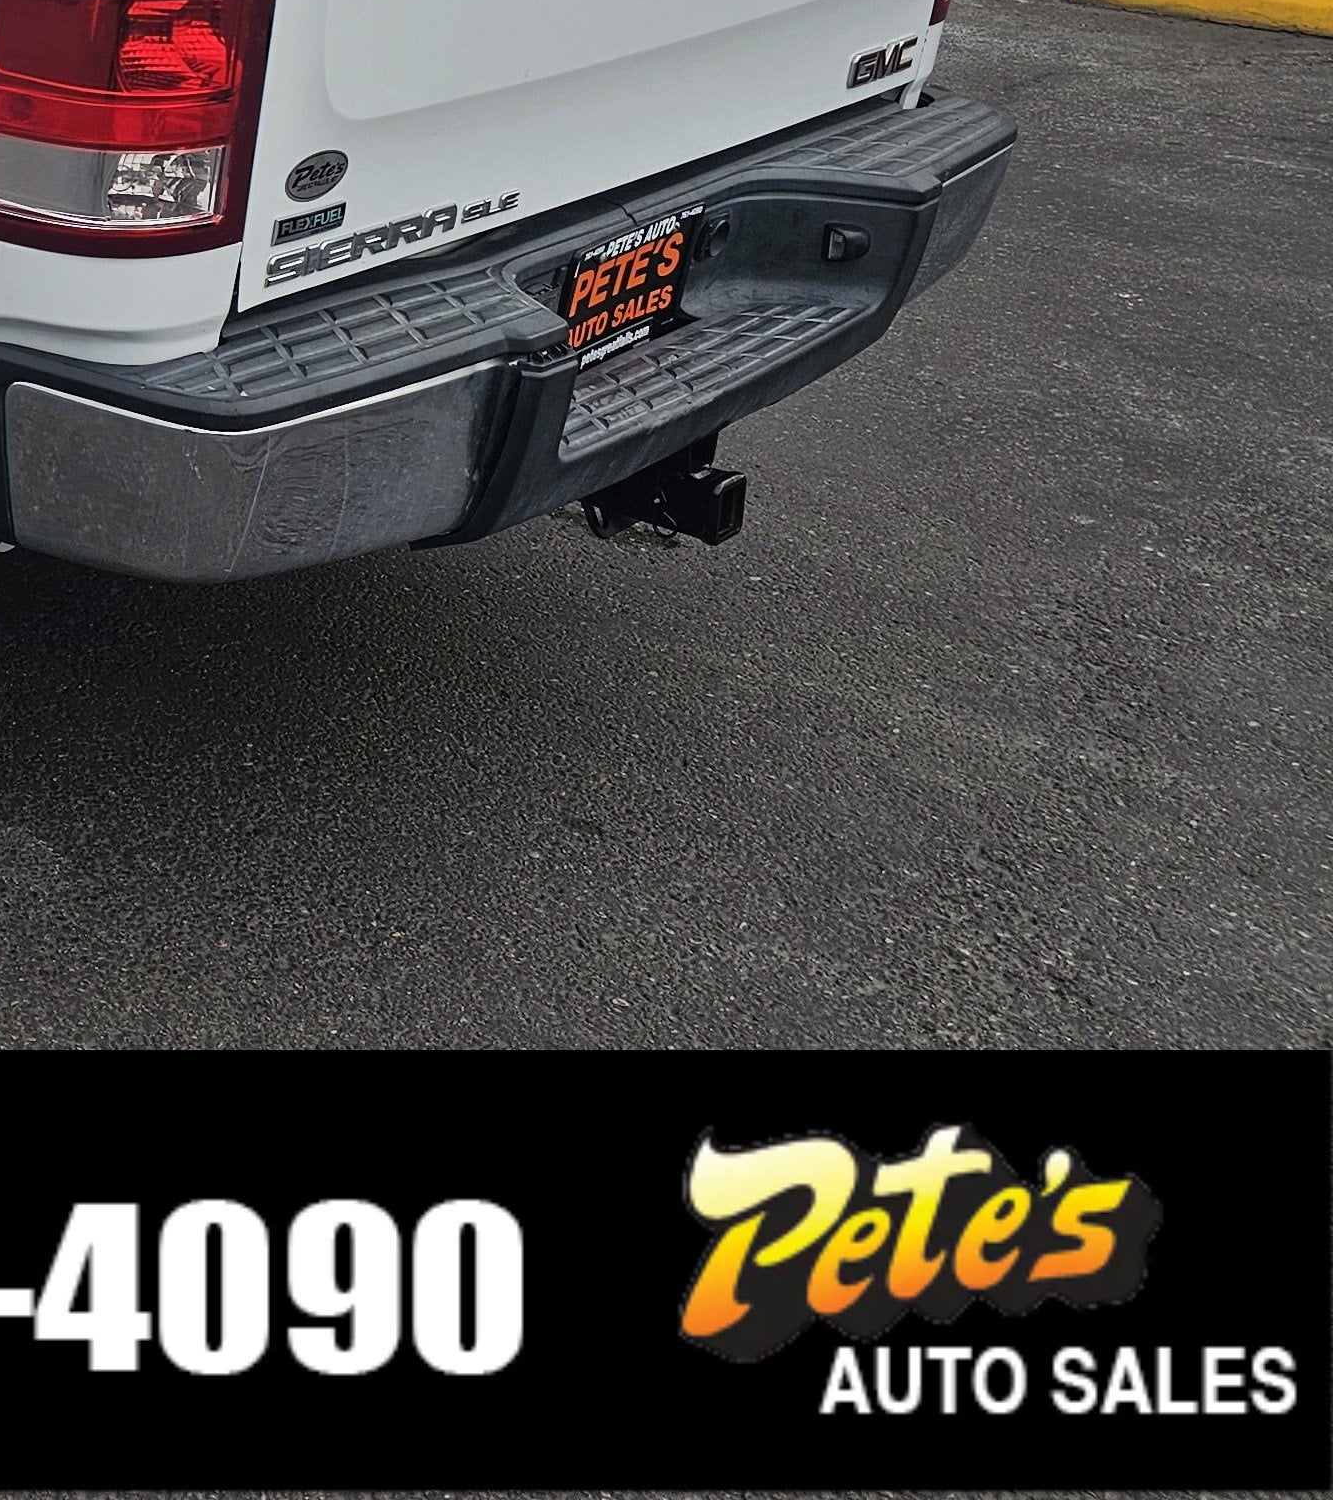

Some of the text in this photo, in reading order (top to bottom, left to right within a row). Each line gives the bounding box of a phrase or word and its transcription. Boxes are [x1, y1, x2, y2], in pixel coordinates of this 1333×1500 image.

[846, 34, 918, 89] GMC
[292, 161, 346, 188] Pete's
[264, 190, 521, 288] SIERRA SLE
[605, 228, 646, 258] PETE'S
[643, 215, 677, 244] AUTO
[568, 232, 684, 318] PETE'S
[611, 285, 674, 328] SALES
